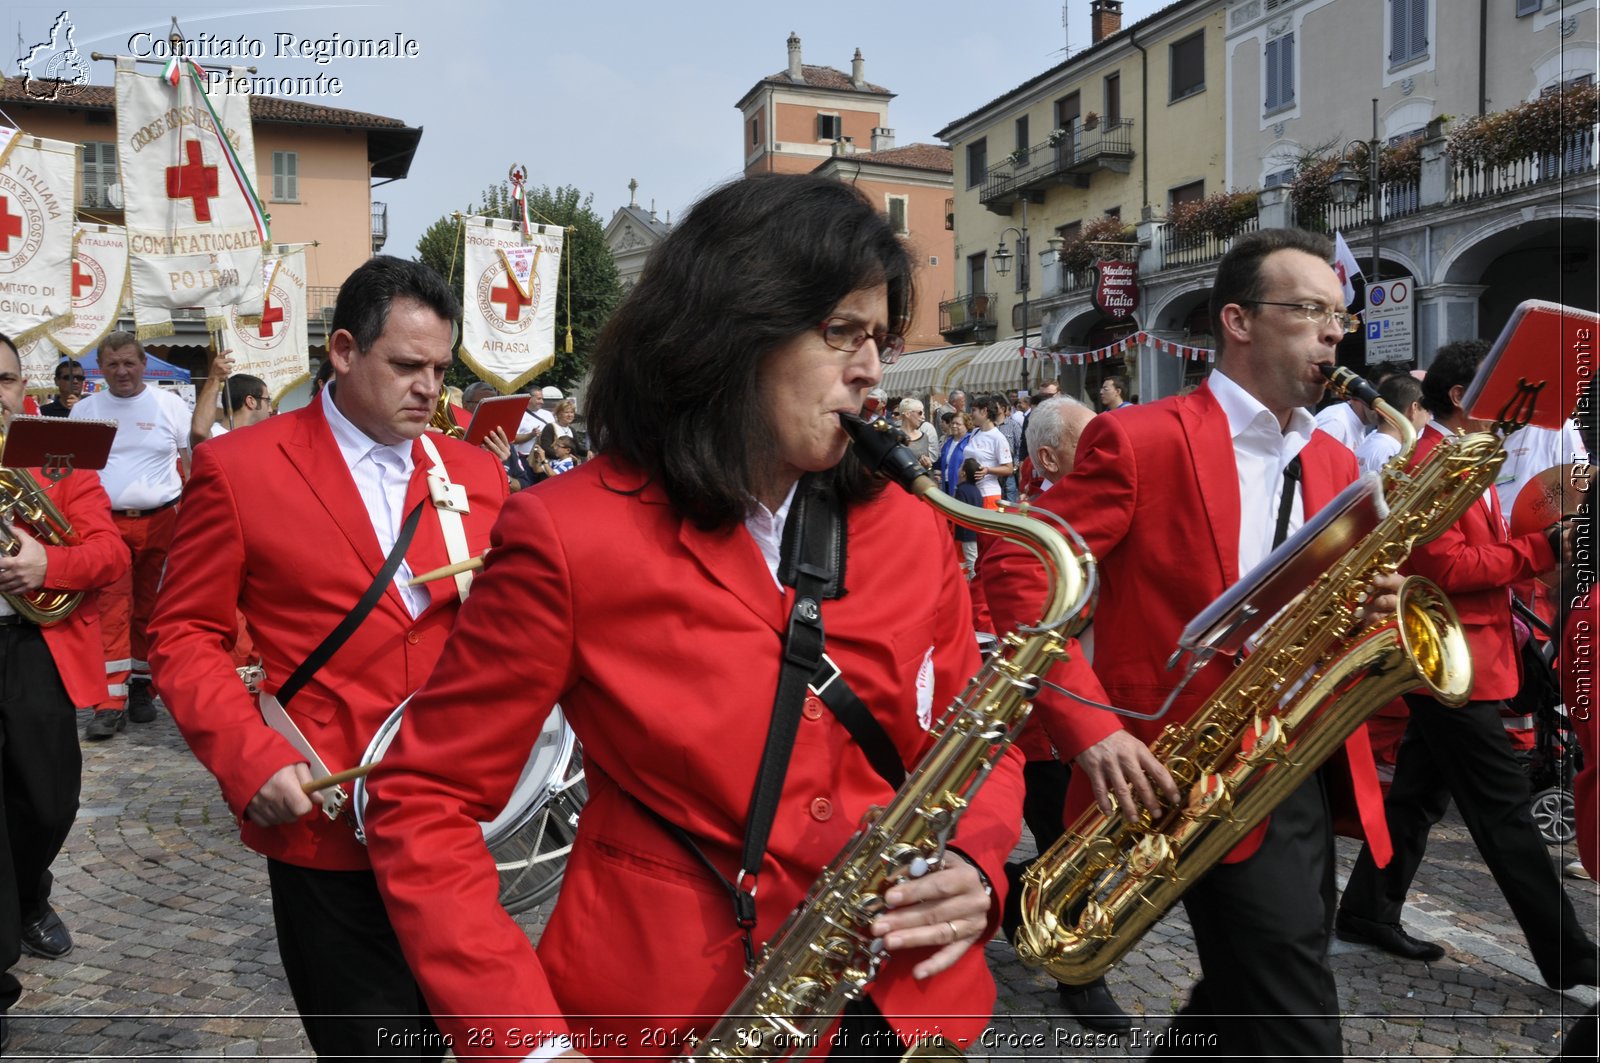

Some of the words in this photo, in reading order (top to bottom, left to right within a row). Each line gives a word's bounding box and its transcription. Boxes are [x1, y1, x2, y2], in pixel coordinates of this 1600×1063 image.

[17, 164, 62, 220] ITALIANA
[27, 208, 42, 252] AGOSTO
[1102, 265, 1133, 276] Macelleria
[1103, 276, 1132, 287] Salumeria
[42, 286, 55, 297] DI
[1102, 287, 1124, 295] Piazza
[1104, 294, 1134, 307] Italia
[482, 340, 530, 354] AIRASCA
